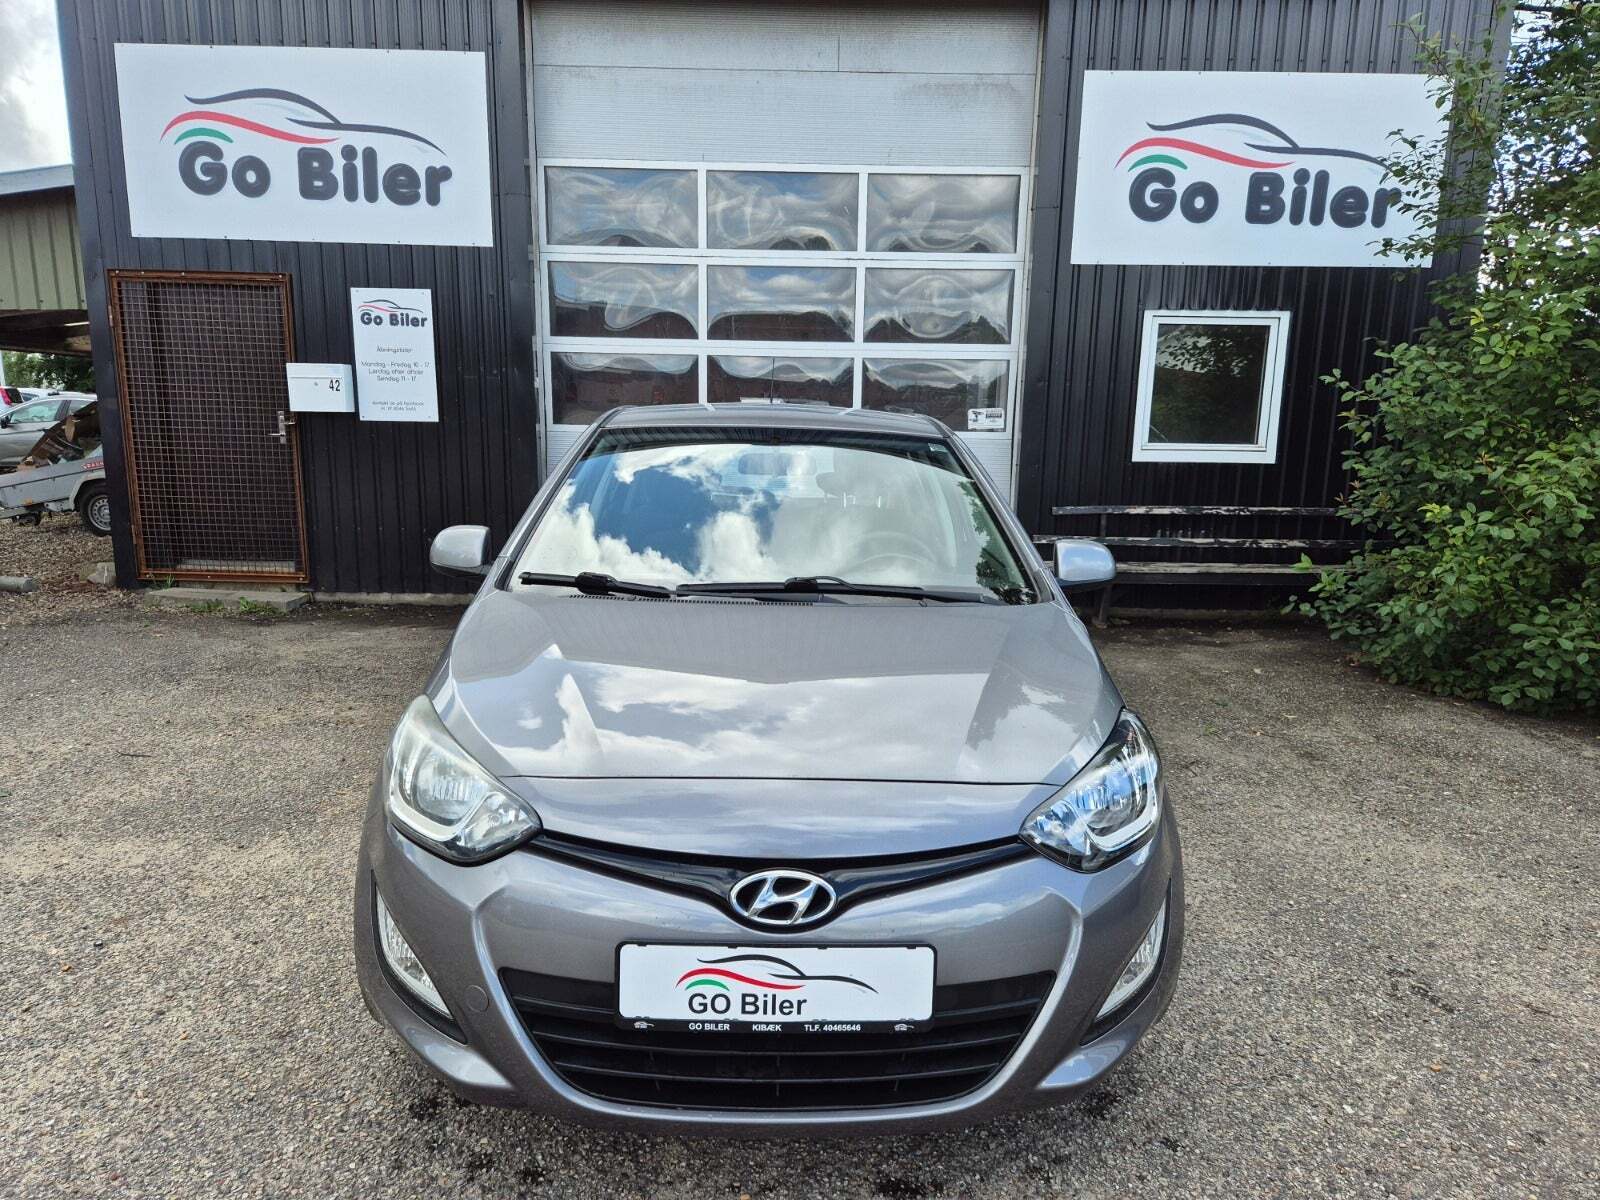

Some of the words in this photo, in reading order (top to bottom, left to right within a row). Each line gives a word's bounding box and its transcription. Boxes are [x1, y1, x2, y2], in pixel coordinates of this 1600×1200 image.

[178, 140, 271, 198] Go
[297, 144, 453, 207] Biler
[1129, 167, 1219, 224] Go
[1244, 167, 1402, 228] Biler
[360, 311, 383, 326] Go
[389, 312, 428, 327] Biler
[328, 379, 341, 392] 42
[688, 993, 731, 1014] GO
[741, 993, 807, 1016] Biler
[688, 1022, 702, 1031] GO
[704, 1023, 730, 1031] BILER
[752, 1024, 782, 1032] KIBÆK
[804, 1024, 821, 1032] TLF.
